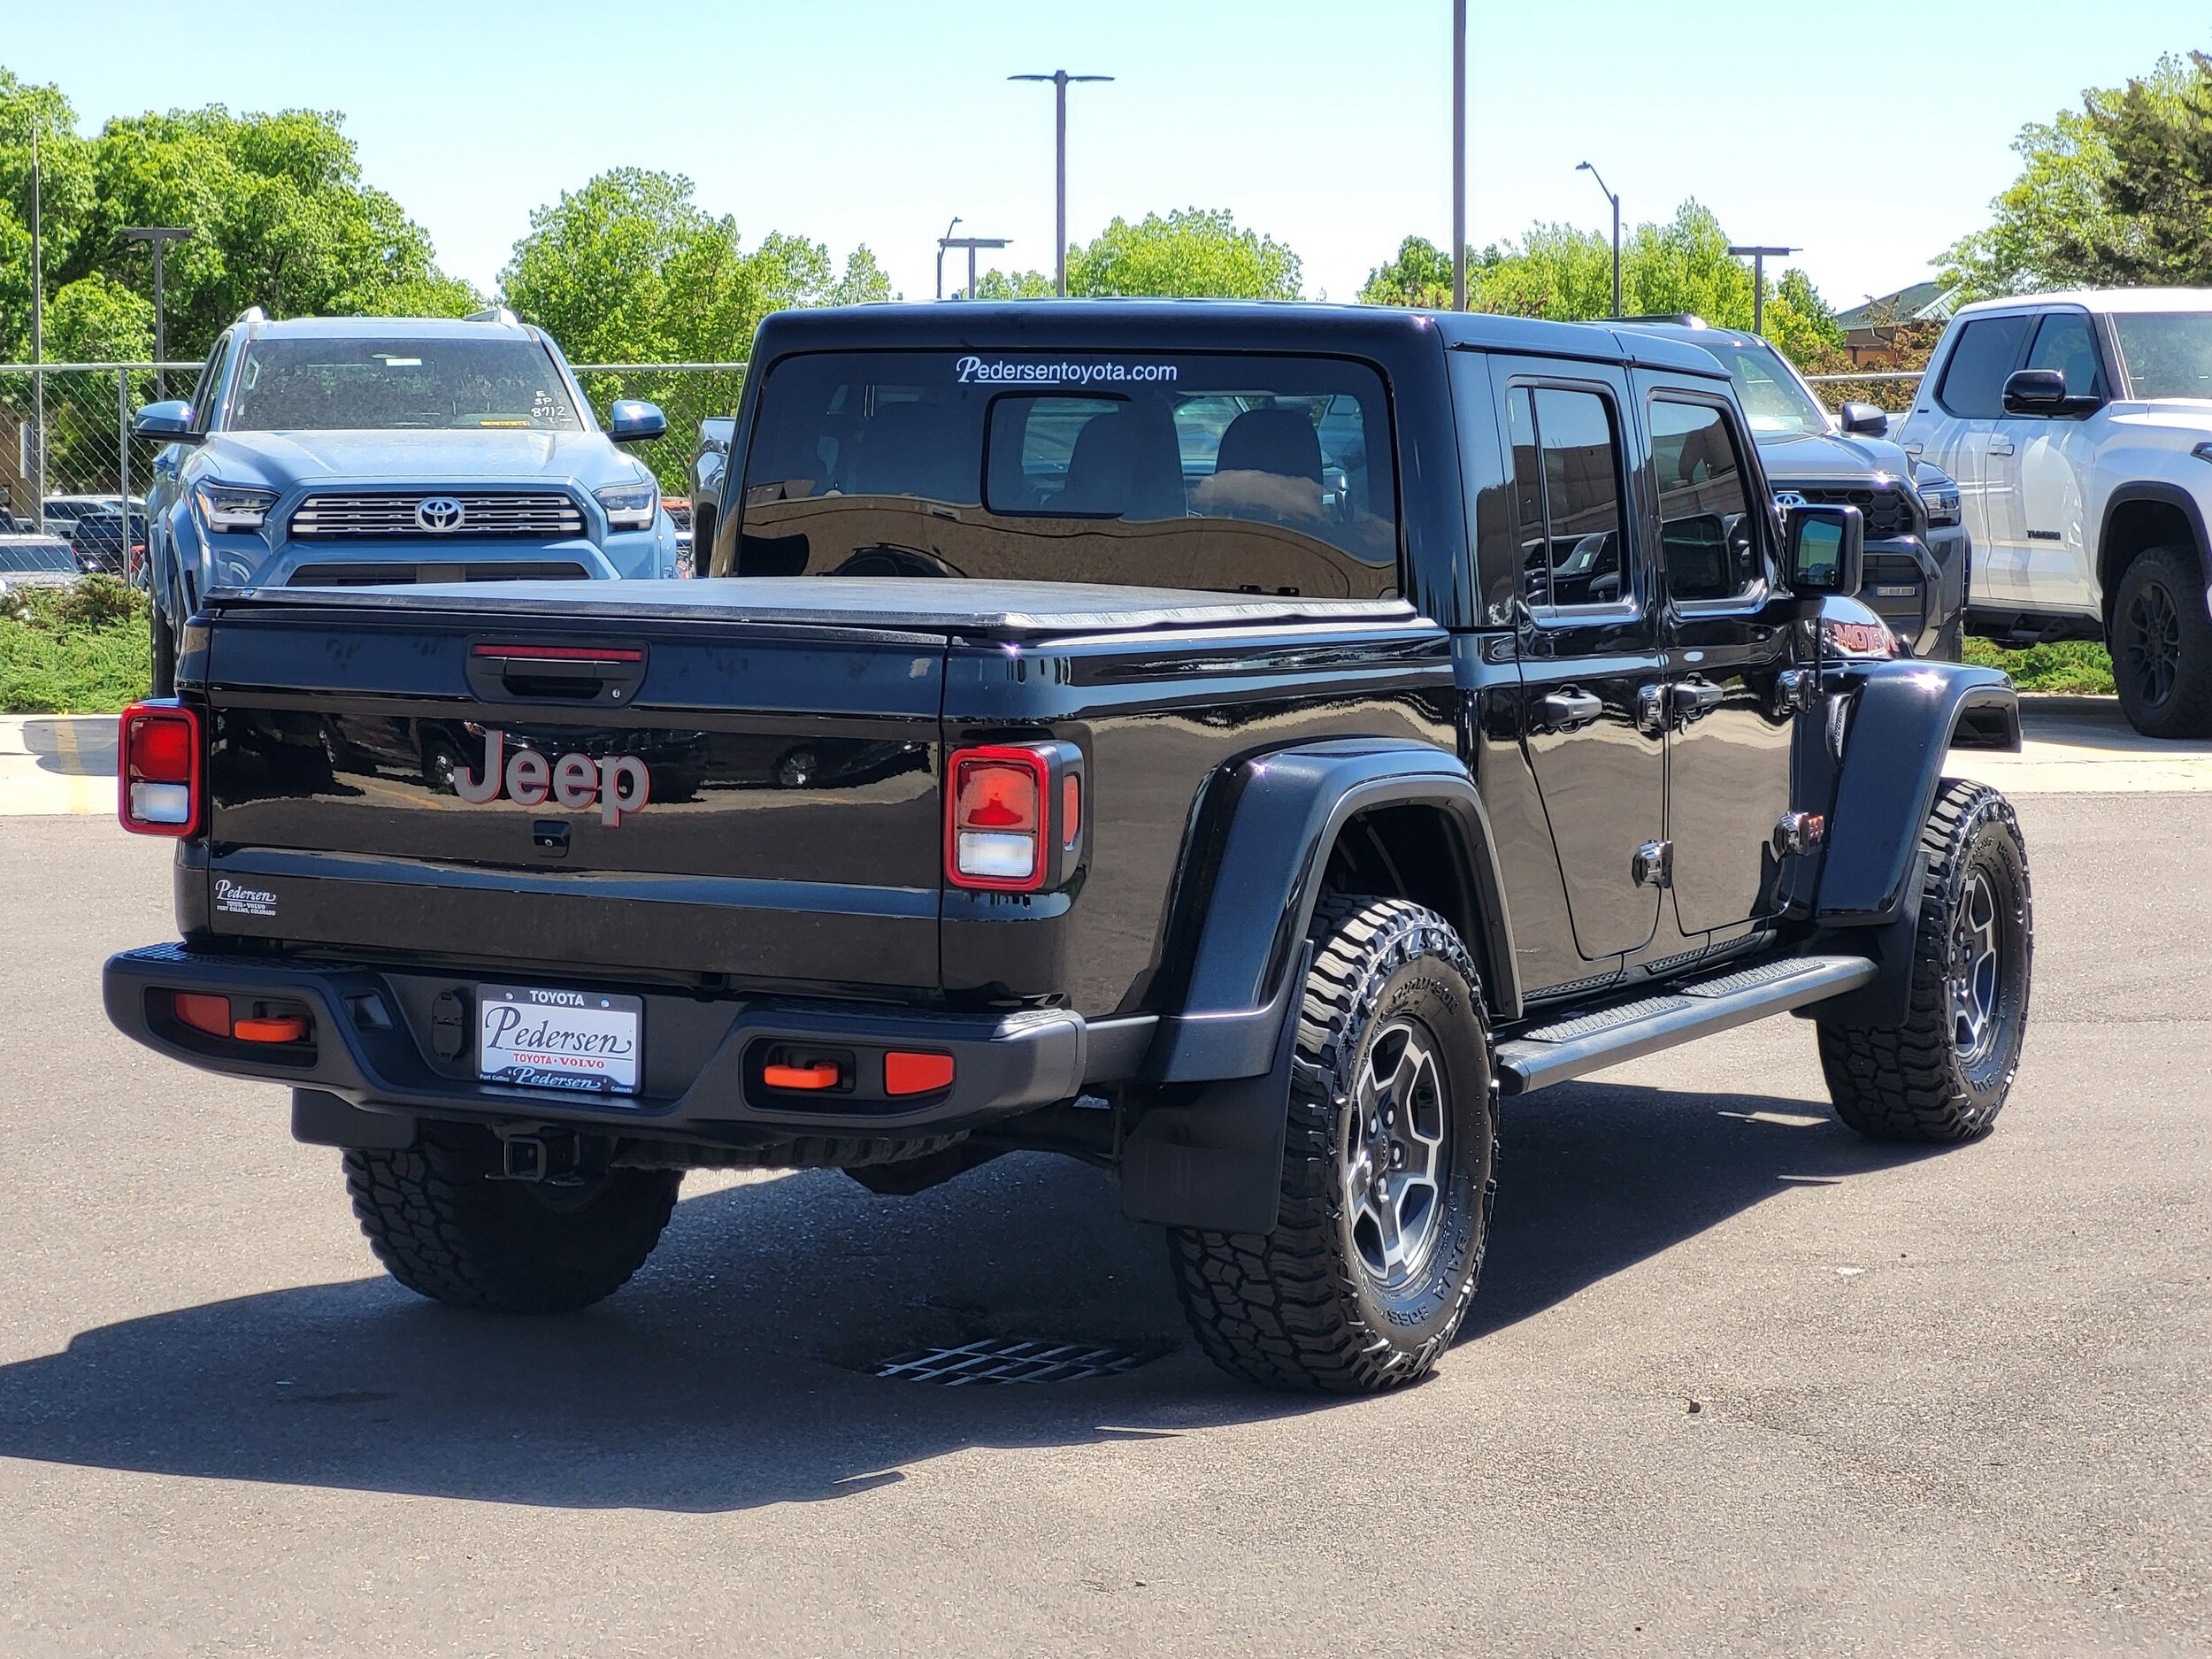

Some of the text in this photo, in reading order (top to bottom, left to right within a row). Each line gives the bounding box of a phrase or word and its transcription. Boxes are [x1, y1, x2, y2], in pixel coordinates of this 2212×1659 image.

[956, 356, 1178, 385] Pedersentoyota.com
[453, 730, 650, 828] Jeep
[215, 879, 277, 902] Pedersen
[529, 990, 585, 1006] TOYOTA
[485, 1006, 633, 1054] Pedersen
[513, 1053, 605, 1069] TOYOTA VOLVO
[513, 1067, 602, 1089] Pedersen
